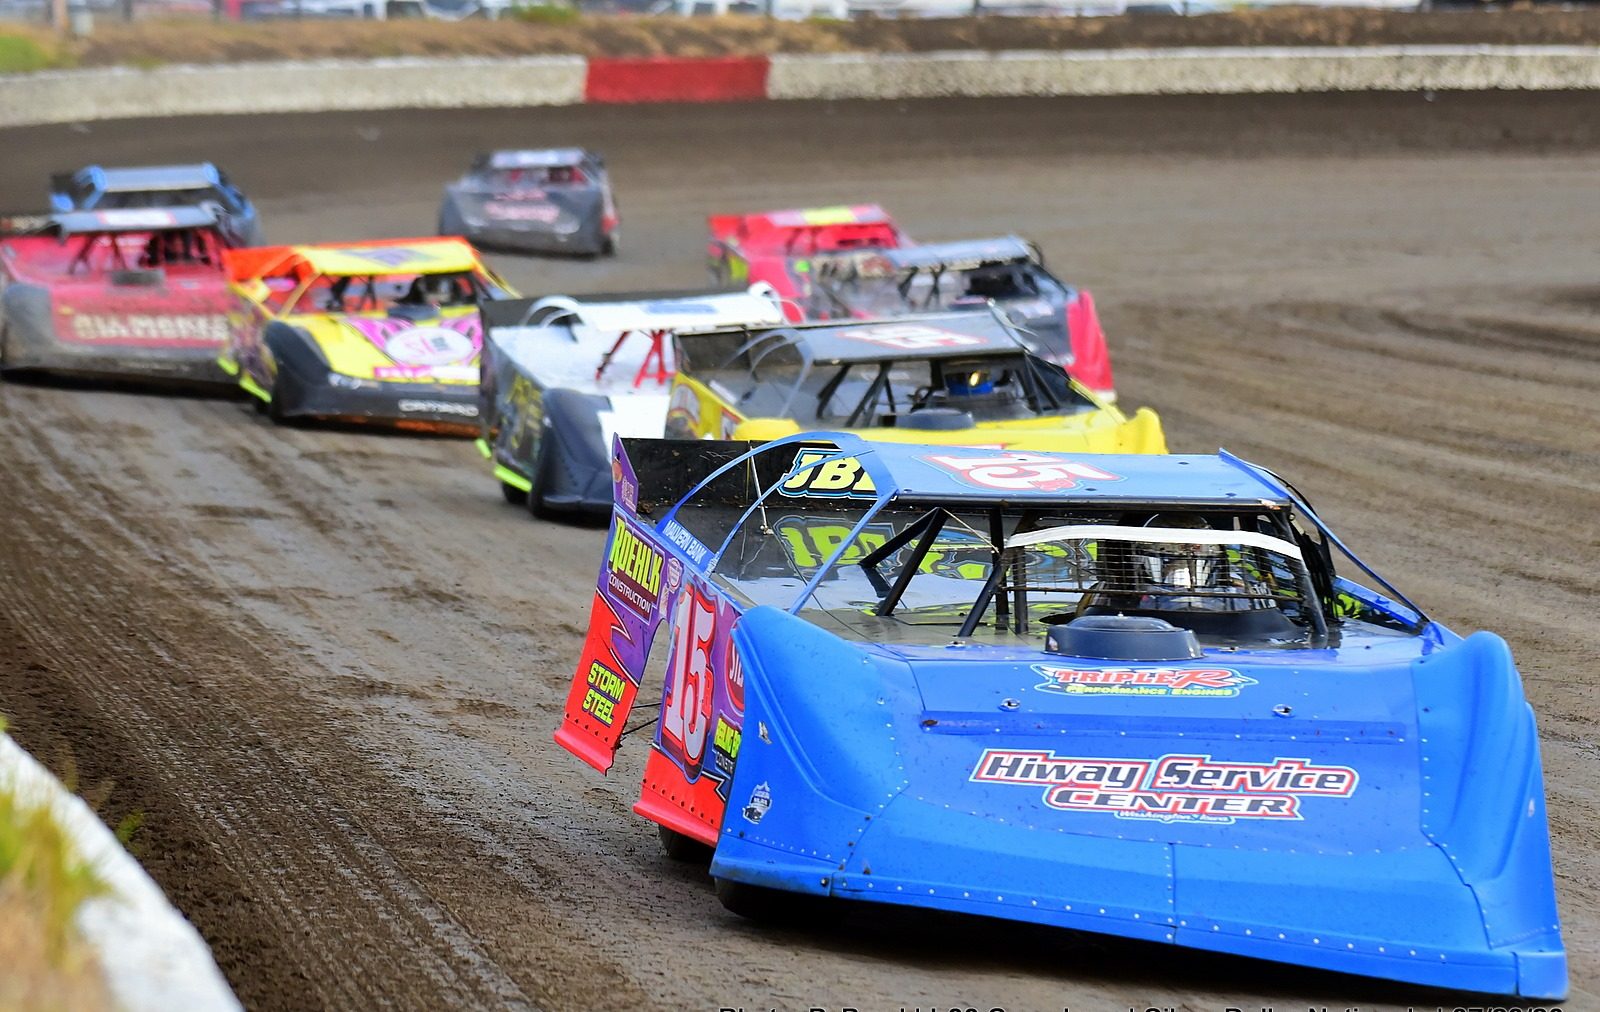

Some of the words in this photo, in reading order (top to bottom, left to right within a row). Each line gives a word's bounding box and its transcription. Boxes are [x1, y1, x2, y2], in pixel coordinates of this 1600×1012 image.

[924, 453, 1119, 490] 15
[609, 516, 663, 597] ROEHLK
[686, 539, 707, 565] BANK
[608, 573, 651, 614] CONSTRUCTION
[586, 662, 627, 702] STORM
[1065, 685, 1167, 695] PERFORMANCE
[1171, 687, 1233, 696] ENGINES
[582, 688, 616, 725] STEEL
[985, 755, 1142, 789] Hiway
[1157, 760, 1347, 792] Service
[1054, 789, 1291, 815] CENTER
